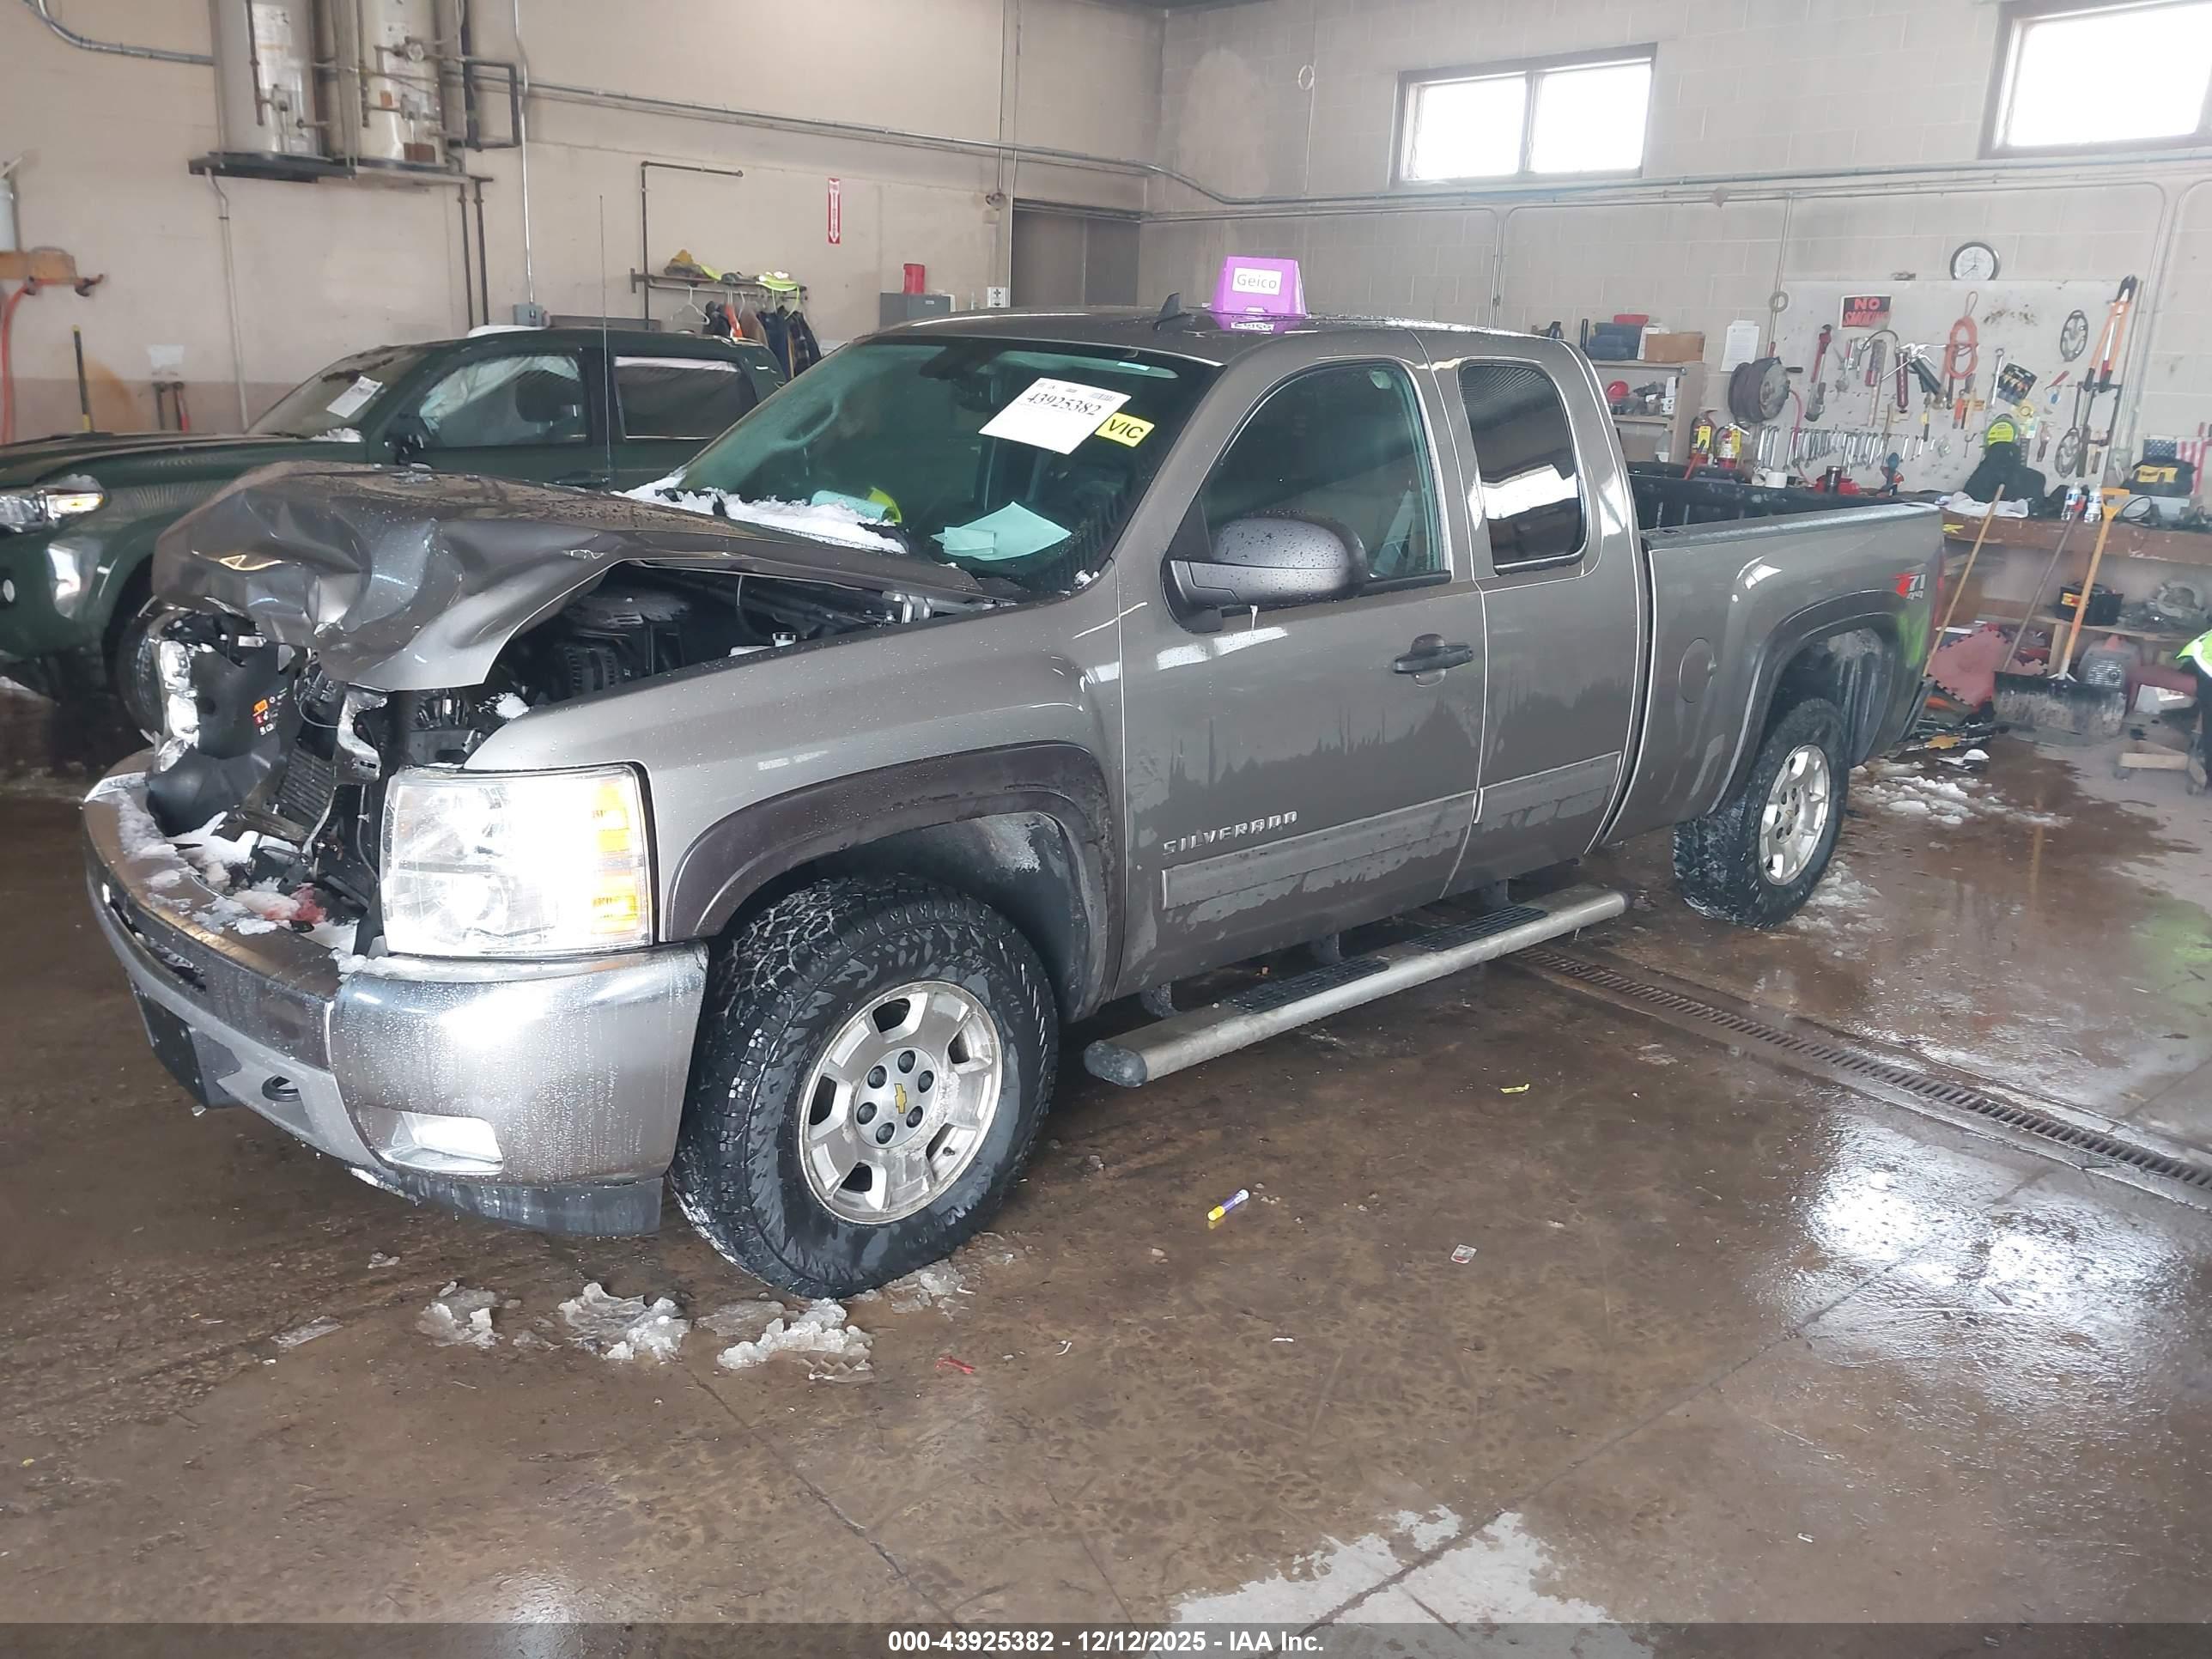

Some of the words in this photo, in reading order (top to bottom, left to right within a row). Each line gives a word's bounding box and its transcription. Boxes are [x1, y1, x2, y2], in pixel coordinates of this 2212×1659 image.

[1237, 274, 1277, 289] Geico
[1854, 298, 1881, 310] NO
[1027, 392, 1102, 416] 43925382
[1108, 419, 1144, 439] VIC
[1162, 811, 1297, 855] SILVERADO
